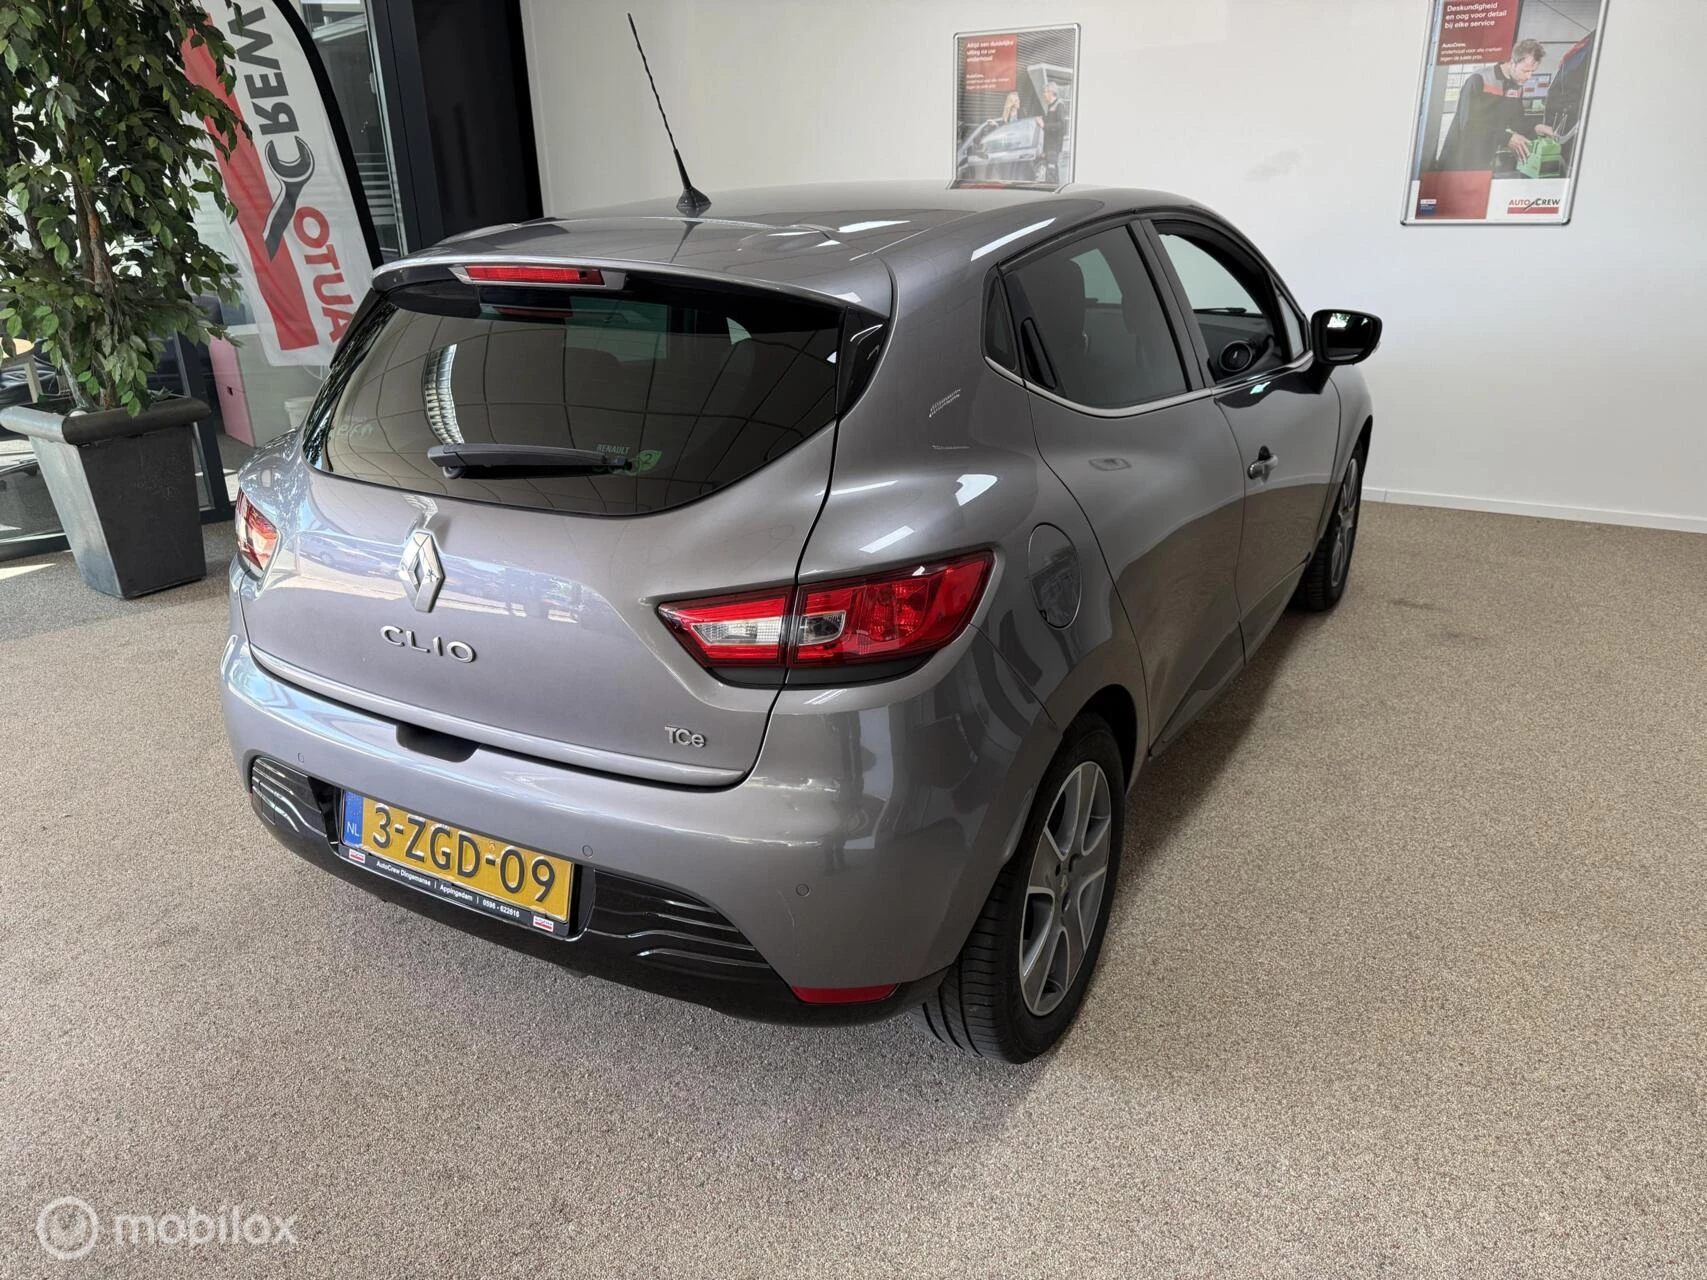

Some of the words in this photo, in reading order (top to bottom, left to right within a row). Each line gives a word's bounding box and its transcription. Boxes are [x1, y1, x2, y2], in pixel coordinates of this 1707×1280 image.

[1447, 2, 1498, 12] Deskundigheid
[596, 443, 631, 454] RENAULT
[380, 625, 478, 664] CLIO
[664, 725, 706, 748] TCe
[346, 821, 361, 838] NL
[372, 803, 556, 902] 3-ZGD-09
[376, 860, 401, 875] AutoCrew
[400, 870, 432, 887] Dingemanse
[439, 884, 474, 902] Appingedam
